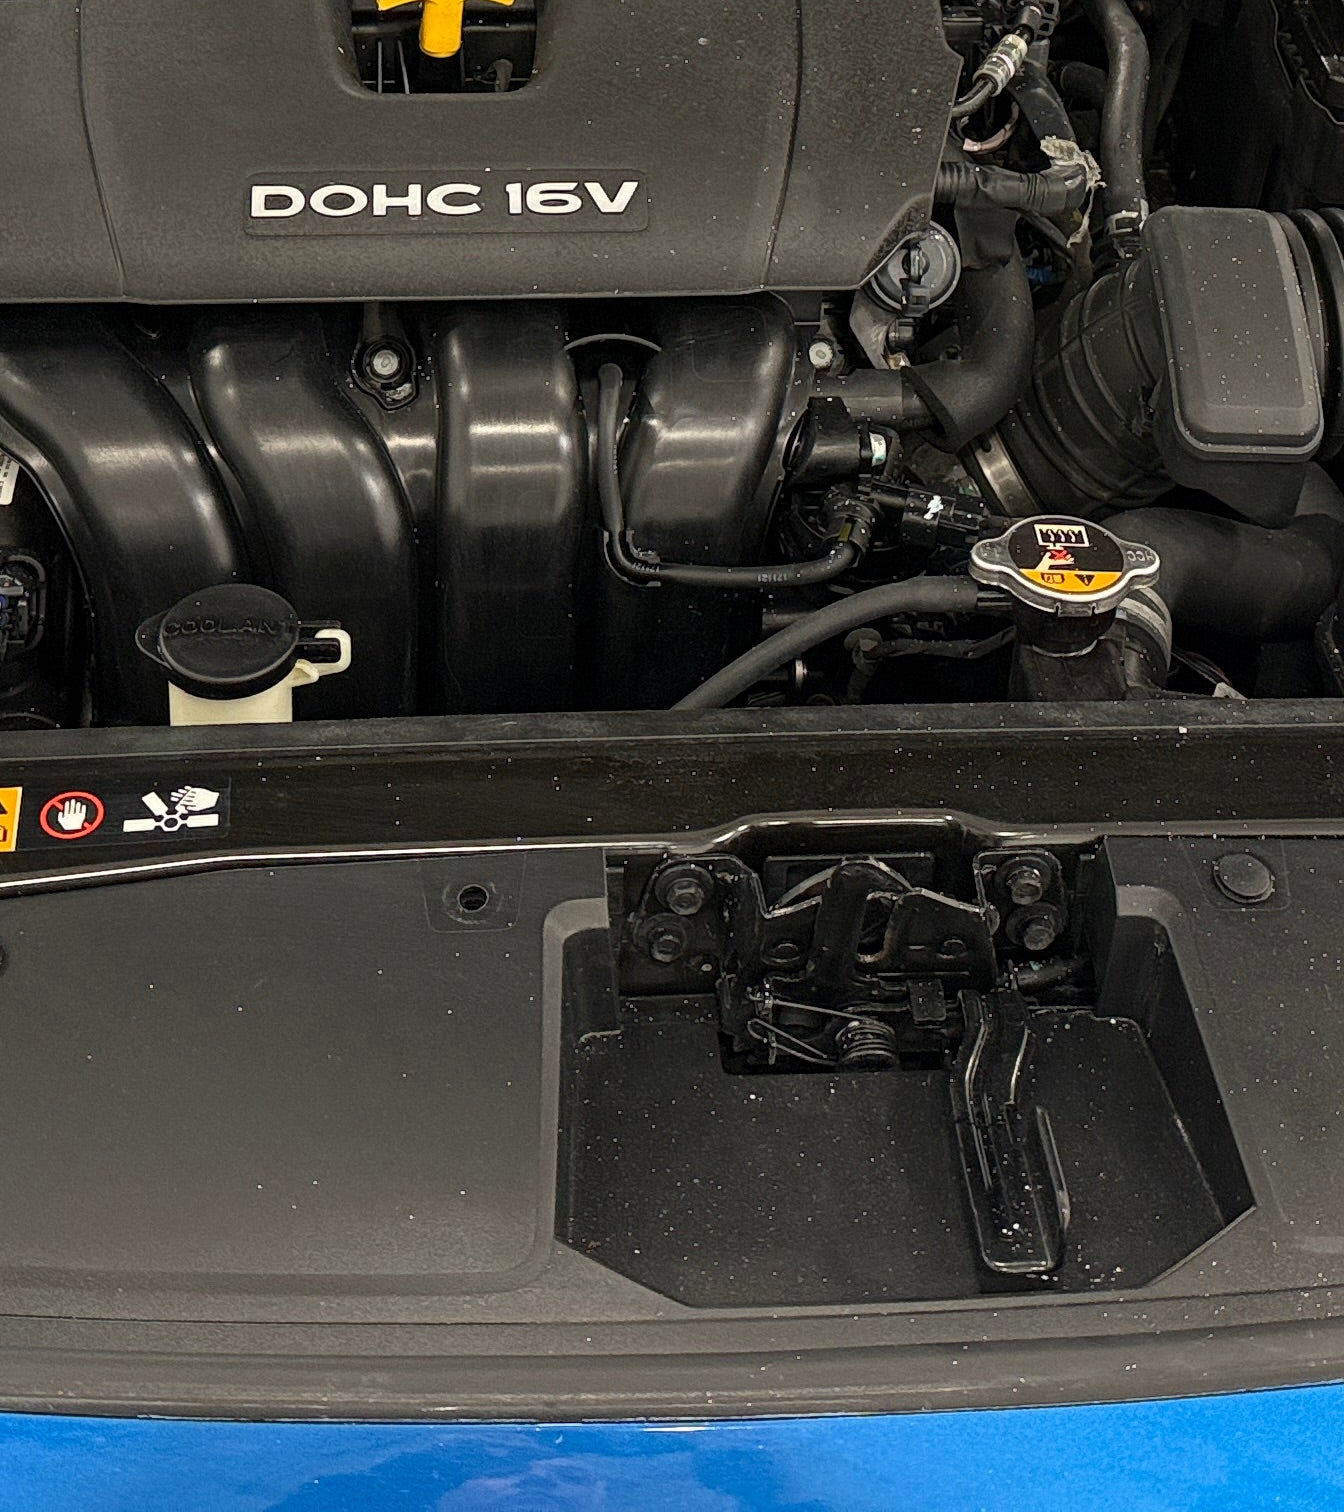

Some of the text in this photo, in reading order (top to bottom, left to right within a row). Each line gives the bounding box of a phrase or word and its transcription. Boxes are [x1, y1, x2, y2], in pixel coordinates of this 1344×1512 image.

[250, 181, 639, 218] DOHC 16V
[164, 615, 293, 637] COOLANT
